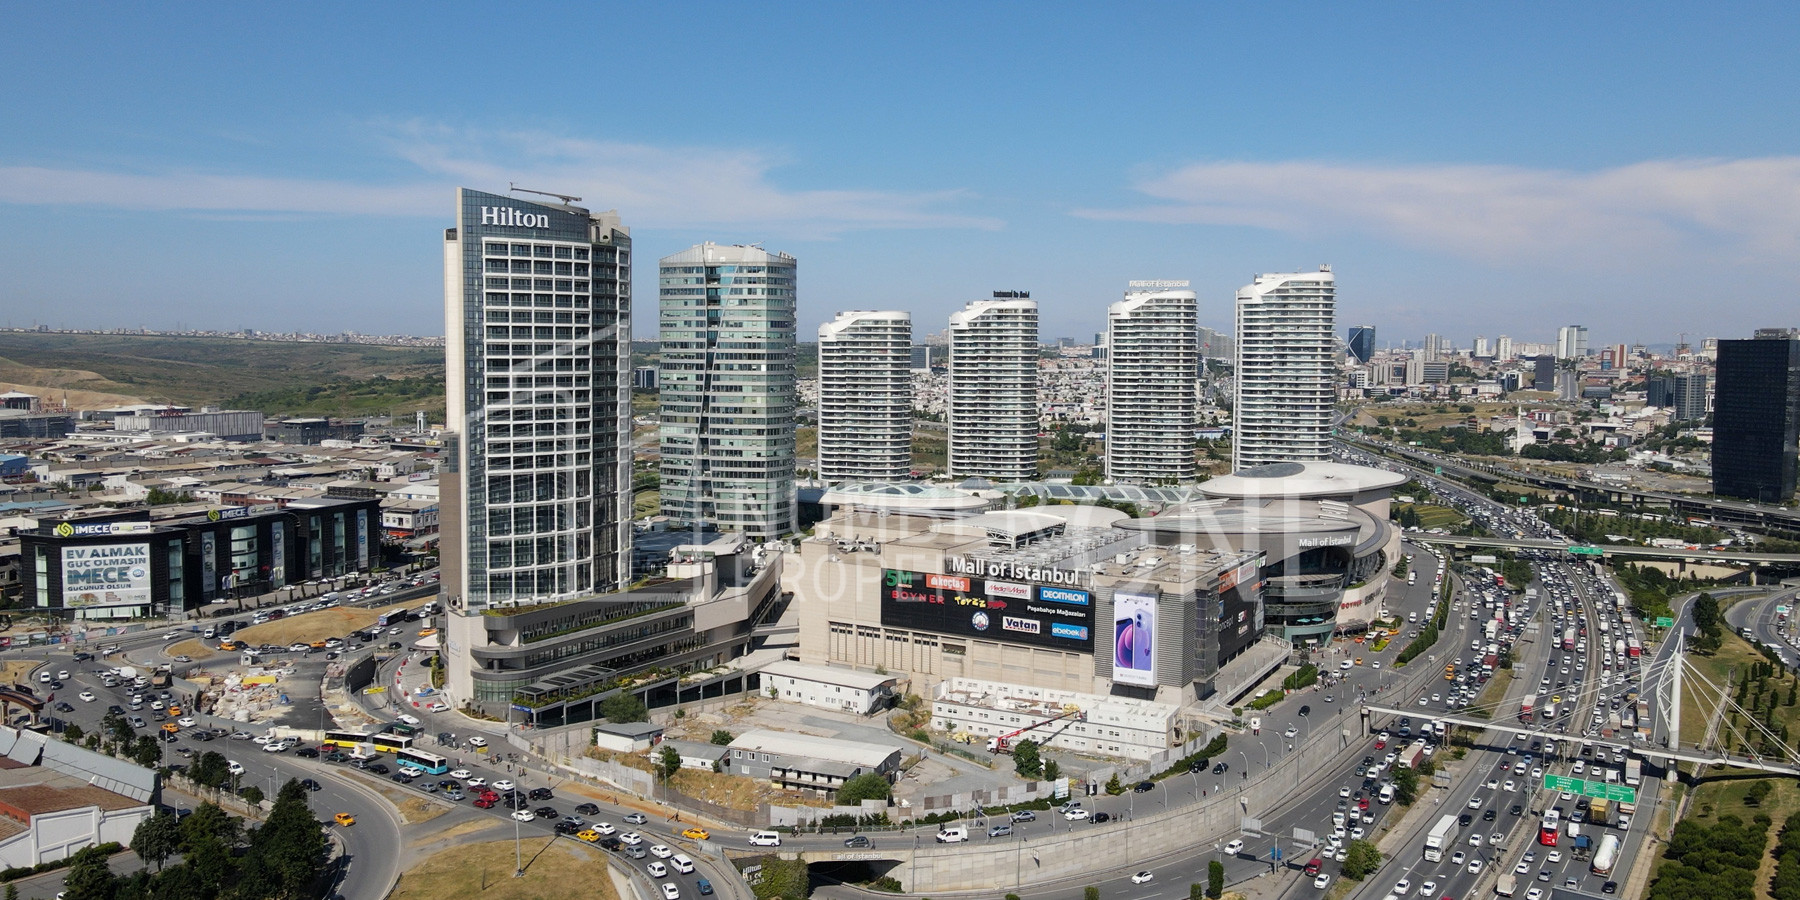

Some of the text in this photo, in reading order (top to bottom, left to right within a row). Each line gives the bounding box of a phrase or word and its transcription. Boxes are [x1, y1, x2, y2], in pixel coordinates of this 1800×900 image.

[481, 206, 549, 229] Hilton
[1299, 538, 1318, 546] Mall
[1319, 537, 1329, 546] of
[66, 546, 145, 559] EV ALMAK
[93, 558, 146, 566] OLMASIN
[952, 557, 984, 575] Mall
[989, 561, 1006, 577] of
[886, 570, 912, 587] 5M
[891, 590, 945, 605] BOYNER
[1043, 590, 1085, 602] DECATHLON
[1005, 618, 1038, 629] Vatan
[1052, 626, 1080, 637] ebebek
[742, 864, 762, 873] Hilton
